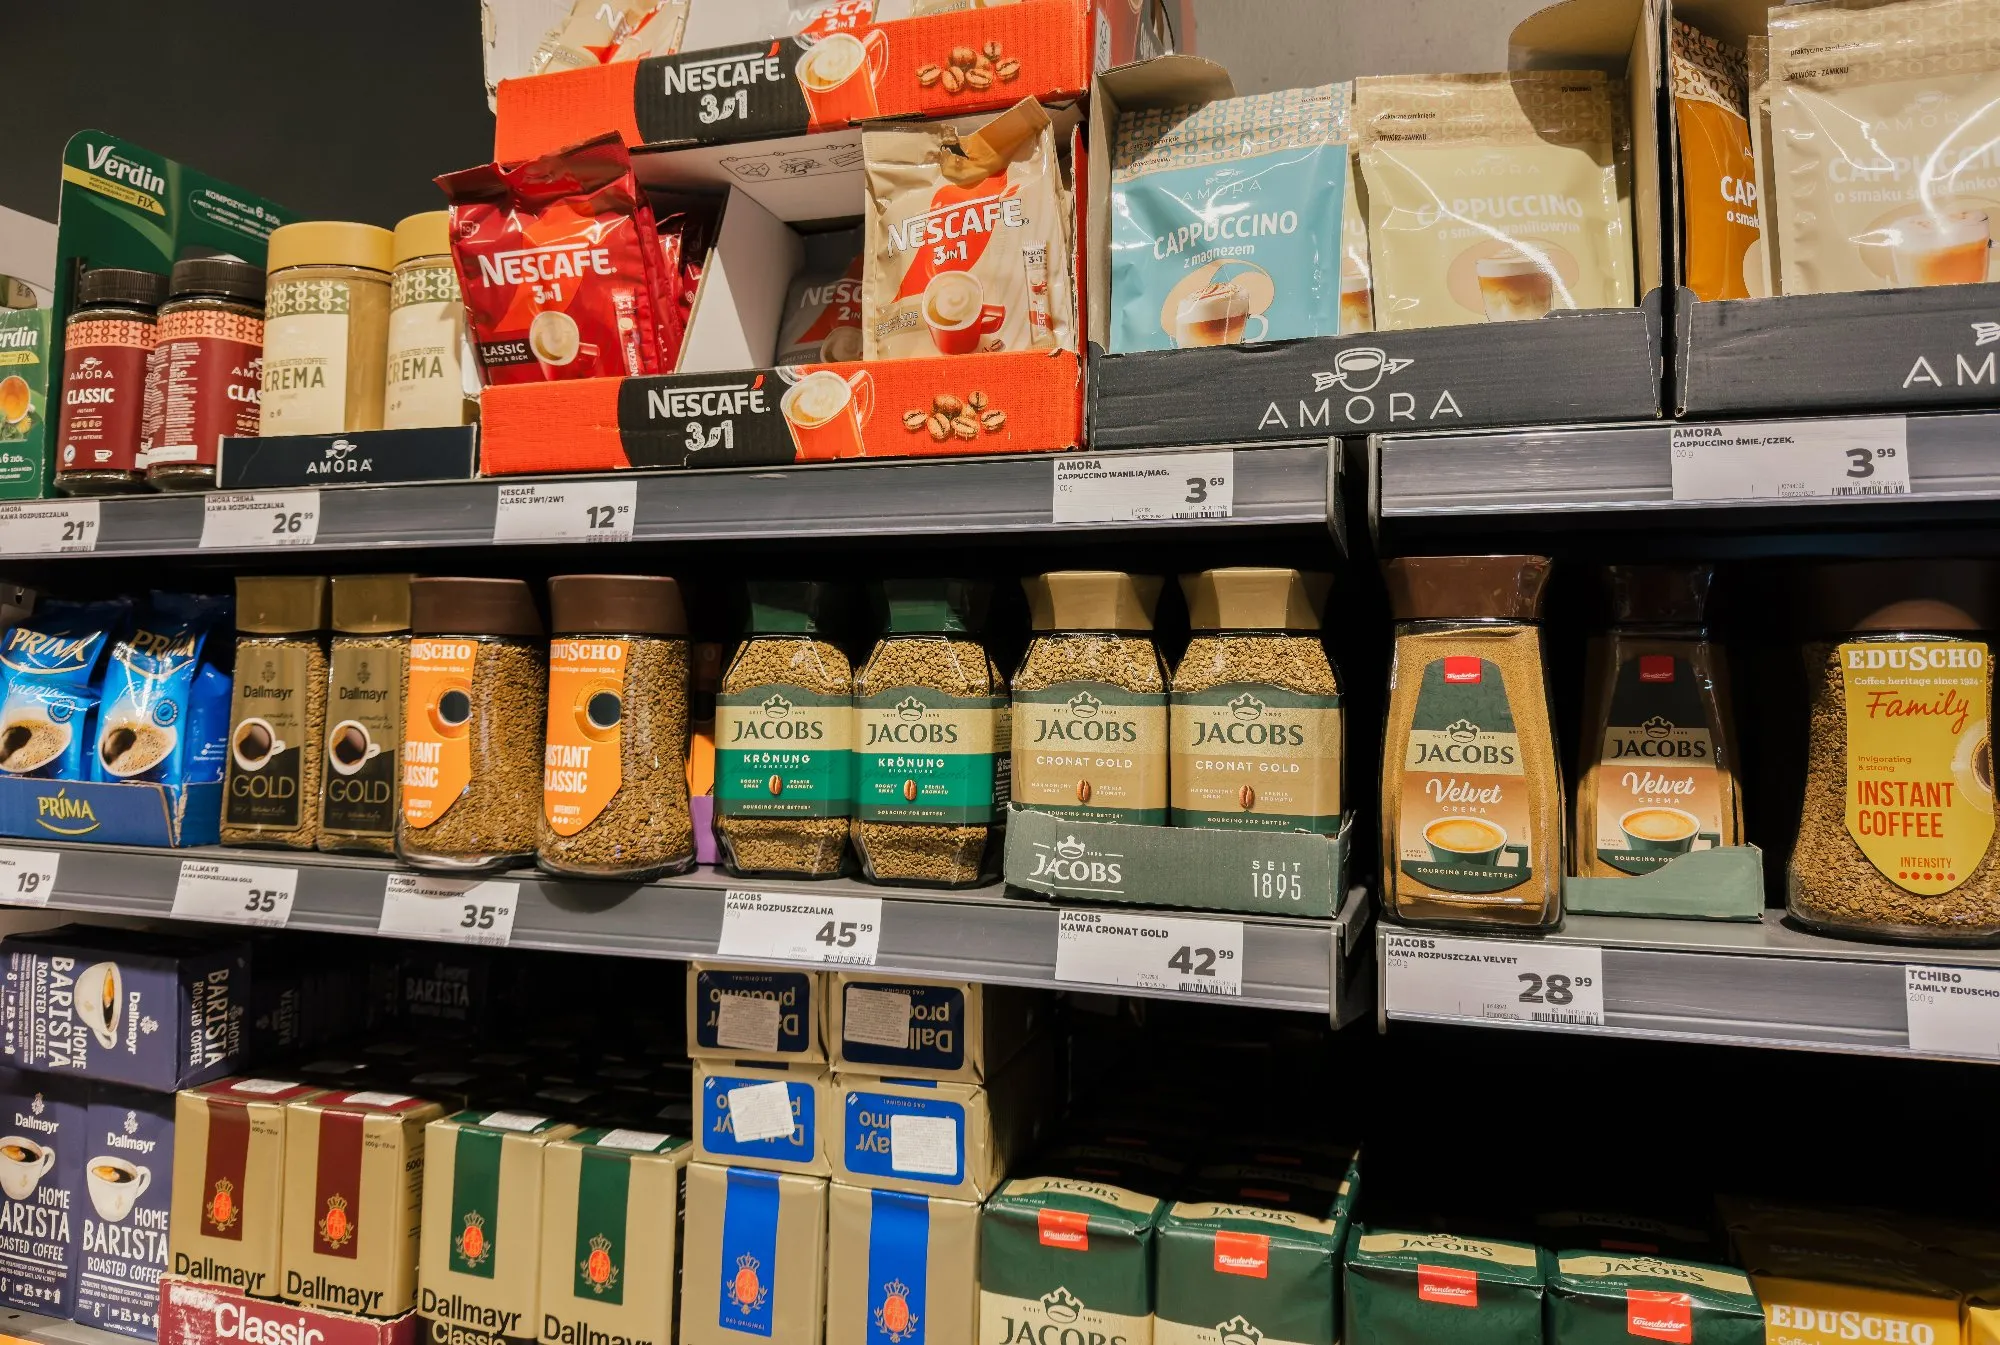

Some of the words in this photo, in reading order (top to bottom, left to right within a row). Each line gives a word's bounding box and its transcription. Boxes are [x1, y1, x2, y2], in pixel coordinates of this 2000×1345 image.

[87, 143, 165, 196] Verdin
[137, 194, 156, 210] FIX
[255, 206, 265, 219] 6
[1416, 194, 1583, 226] CAPPUCCINO
[1726, 211, 1734, 223] o
[1153, 210, 1298, 261] CAPPUCCINO
[1184, 258, 1190, 268] z
[1191, 244, 1255, 266] magnezem
[69, 370, 114, 380] AMORA
[265, 366, 326, 392] CREMA
[388, 356, 444, 386] CREMA
[1902, 352, 1996, 389] AM
[67, 388, 115, 404] CLASSIC
[1258, 390, 1464, 431] AMORA
[1673, 427, 1723, 438] AMORA
[1673, 439, 1734, 448] CAPPUCCINO
[1735, 436, 1795, 446] ŚMIE./CZEK.
[306, 459, 373, 475] AMORA
[1057, 460, 1102, 471] AMORA
[1846, 448, 1876, 478] 3
[1878, 448, 1896, 458] 99
[1057, 472, 1108, 480] CAPPUCCINO
[1108, 470, 1170, 479] WANILIA/MAG.
[500, 487, 535, 496] NESCAFÉ
[500, 497, 527, 505] CLASIC
[528, 495, 565, 504] 3W1/2W1
[1185, 477, 1208, 504] 3
[1210, 477, 1225, 486] 69
[272, 512, 302, 533] 26
[586, 506, 615, 529] 12
[62, 521, 86, 541] 21
[1848, 646, 1982, 671] EDUSCHO
[243, 685, 293, 700] Dallmayr
[1854, 677, 1886, 686] Coffee
[1887, 676, 1931, 687] heritage
[1933, 677, 1958, 686] since
[339, 686, 388, 703] Dallmayr
[1866, 688, 1970, 735] Family
[732, 720, 823, 743] JACOBS
[866, 723, 958, 746] JACOBS
[1034, 719, 1137, 743] JACOBS
[1192, 721, 1304, 747] JACOBS
[743, 752, 811, 764] KRÖNUNG
[1414, 743, 1514, 765] JACOBS
[1611, 738, 1707, 760] JACOBS
[1858, 755, 1912, 764] Invigorating
[878, 756, 945, 769] KRÖNUNG
[1036, 755, 1089, 767] CRONAT
[1095, 757, 1133, 769] GOLD
[1195, 760, 1253, 772] CRONAT
[1259, 762, 1300, 774] GOLD
[1866, 764, 1895, 773] strong
[232, 774, 296, 799] GOLD
[328, 778, 391, 804] GOLD
[1425, 778, 1503, 805] Velvet
[1622, 771, 1696, 796] Velvet
[1857, 780, 1955, 808] INSTANT
[1442, 805, 1487, 814] CREMA
[1638, 796, 1681, 804] CREMA
[1207, 816, 1243, 824] SOURCING
[1857, 809, 1944, 839] COFFEE
[182, 863, 220, 874] DALLMAYR
[1030, 852, 1122, 884] JACOBS
[1252, 860, 1301, 873] SEIT
[1900, 857, 1952, 869] INTENSITY
[17, 872, 40, 893] 19
[389, 878, 416, 887] TCHIBO
[1251, 871, 1301, 900] 1895
[244, 889, 277, 913] 35
[278, 892, 288, 900] 99
[727, 892, 762, 901] JACOBS
[460, 904, 496, 930] 35
[498, 907, 509, 915] 99
[726, 902, 755, 911] KAWA
[756, 903, 834, 916] ROZPUSZCZALNA
[1061, 912, 1102, 923] JACOBS
[815, 921, 858, 948] 45
[860, 923, 873, 933] 99
[1060, 923, 1093, 933] KAWA
[1095, 925, 1139, 937] CRONAT
[1140, 928, 1169, 938] GOLD
[1388, 937, 1435, 949] JACOBS
[1167, 945, 1217, 977] 42
[1218, 949, 1234, 959] 99
[1388, 950, 1416, 958] KAWA
[1417, 951, 1482, 962] ROZPUSZCZAL
[1483, 955, 1518, 965] VELVET
[35, 961, 48, 1014] ROASTED
[1908, 969, 1962, 984] TCHIBO
[1517, 972, 1574, 1006] 28
[1574, 976, 1592, 987] 99
[1908, 983, 1947, 993] FAMILY
[1950, 986, 2000, 998] EDUSCHO
[1909, 992, 1926, 1002] 200
[1927, 995, 1934, 1005] g
[48, 956, 75, 1068] BARISTA
[191, 981, 205, 1027] ROASTED
[126, 991, 141, 1055] Dallmayr
[204, 968, 230, 1069] BARISTA
[35, 1017, 46, 1059] COFFEE
[72, 1026, 88, 1070] HOME
[190, 1030, 203, 1067] COFFEE
[15, 1113, 59, 1136] Dallmayr
[107, 1132, 156, 1154] Dallmayr
[38, 1186, 70, 1210] HOME
[1042, 1179, 1121, 1203] JACOBS
[0, 1200, 71, 1244] ARISTA
[134, 1207, 169, 1231] HOME
[1210, 1206, 1297, 1225] JACOBS
[82, 1219, 169, 1267] BARISTA
[1043, 1229, 1083, 1242] Wunderbar
[32, 1242, 64, 1262] COFFEE
[1400, 1237, 1494, 1257] JACOBS
[87, 1256, 127, 1278] ROASTED
[129, 1264, 163, 1285] COFFEE
[1218, 1254, 1265, 1268] Wunderbar
[1603, 1262, 1705, 1282] JACOBS
[175, 1252, 266, 1298] Dallmayr
[287, 1270, 384, 1314] Dallmayr
[1423, 1284, 1474, 1296] Wunderbar
[421, 1287, 522, 1335] Dallmayr
[215, 1300, 324, 1345] Classic
[1632, 1316, 1688, 1331] Wunderbar
[1770, 1303, 1935, 1345] EDUSCHO
